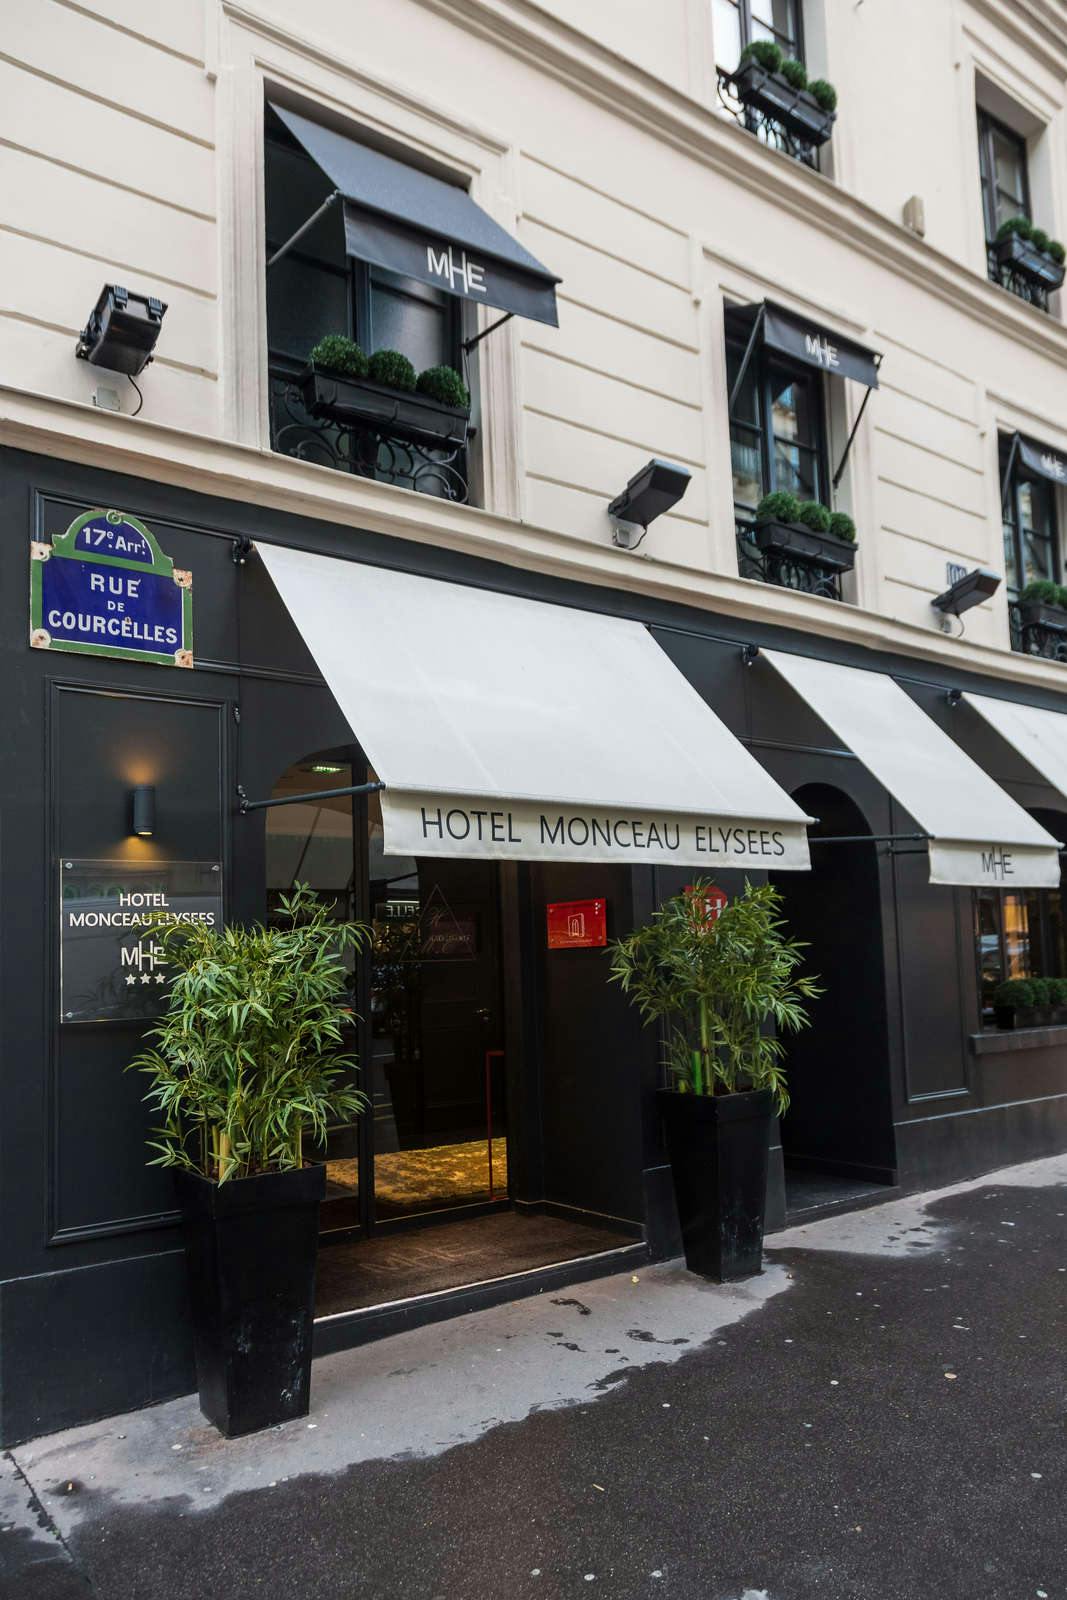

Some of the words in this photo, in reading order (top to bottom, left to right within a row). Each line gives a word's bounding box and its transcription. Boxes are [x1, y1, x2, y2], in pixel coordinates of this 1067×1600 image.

[427, 246, 487, 294] MHE
[805, 334, 840, 368] MHE
[91, 573, 140, 598] RUE
[107, 600, 125, 612] DE
[48, 610, 178, 644] COURCELLES
[420, 807, 522, 843] HOTEL
[539, 815, 680, 850] MONCEAU
[695, 825, 785, 856] ELYSEES
[981, 847, 1015, 880] MHE
[119, 893, 169, 907] HOTEL
[69, 912, 151, 927] MONCEAU
[121, 940, 169, 971] MHE
